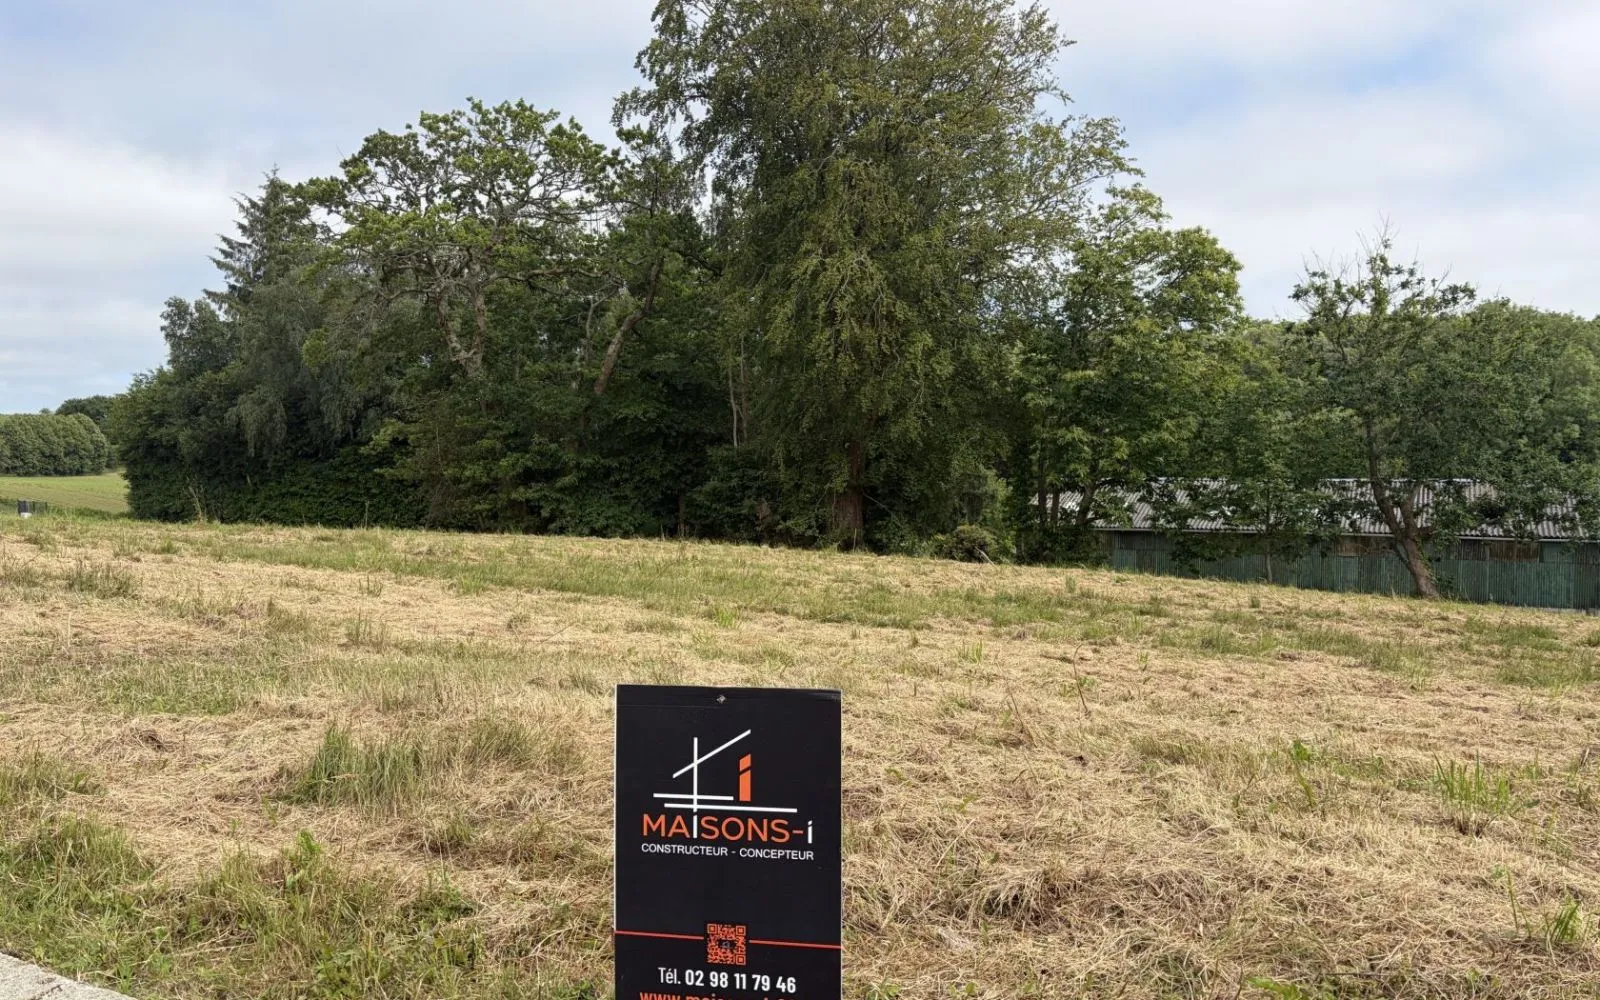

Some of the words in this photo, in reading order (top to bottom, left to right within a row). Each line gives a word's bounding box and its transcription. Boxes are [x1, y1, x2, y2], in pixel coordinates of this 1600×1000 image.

[641, 843, 728, 856] CONSTRUCTEUR
[739, 848, 814, 861] CONCEPTEUR
[658, 967, 681, 984] Tél.
[685, 969, 705, 987] 02
[709, 971, 729, 988] 98
[733, 973, 747, 990] 11
[751, 974, 771, 991] 79
[775, 976, 796, 993] 46
